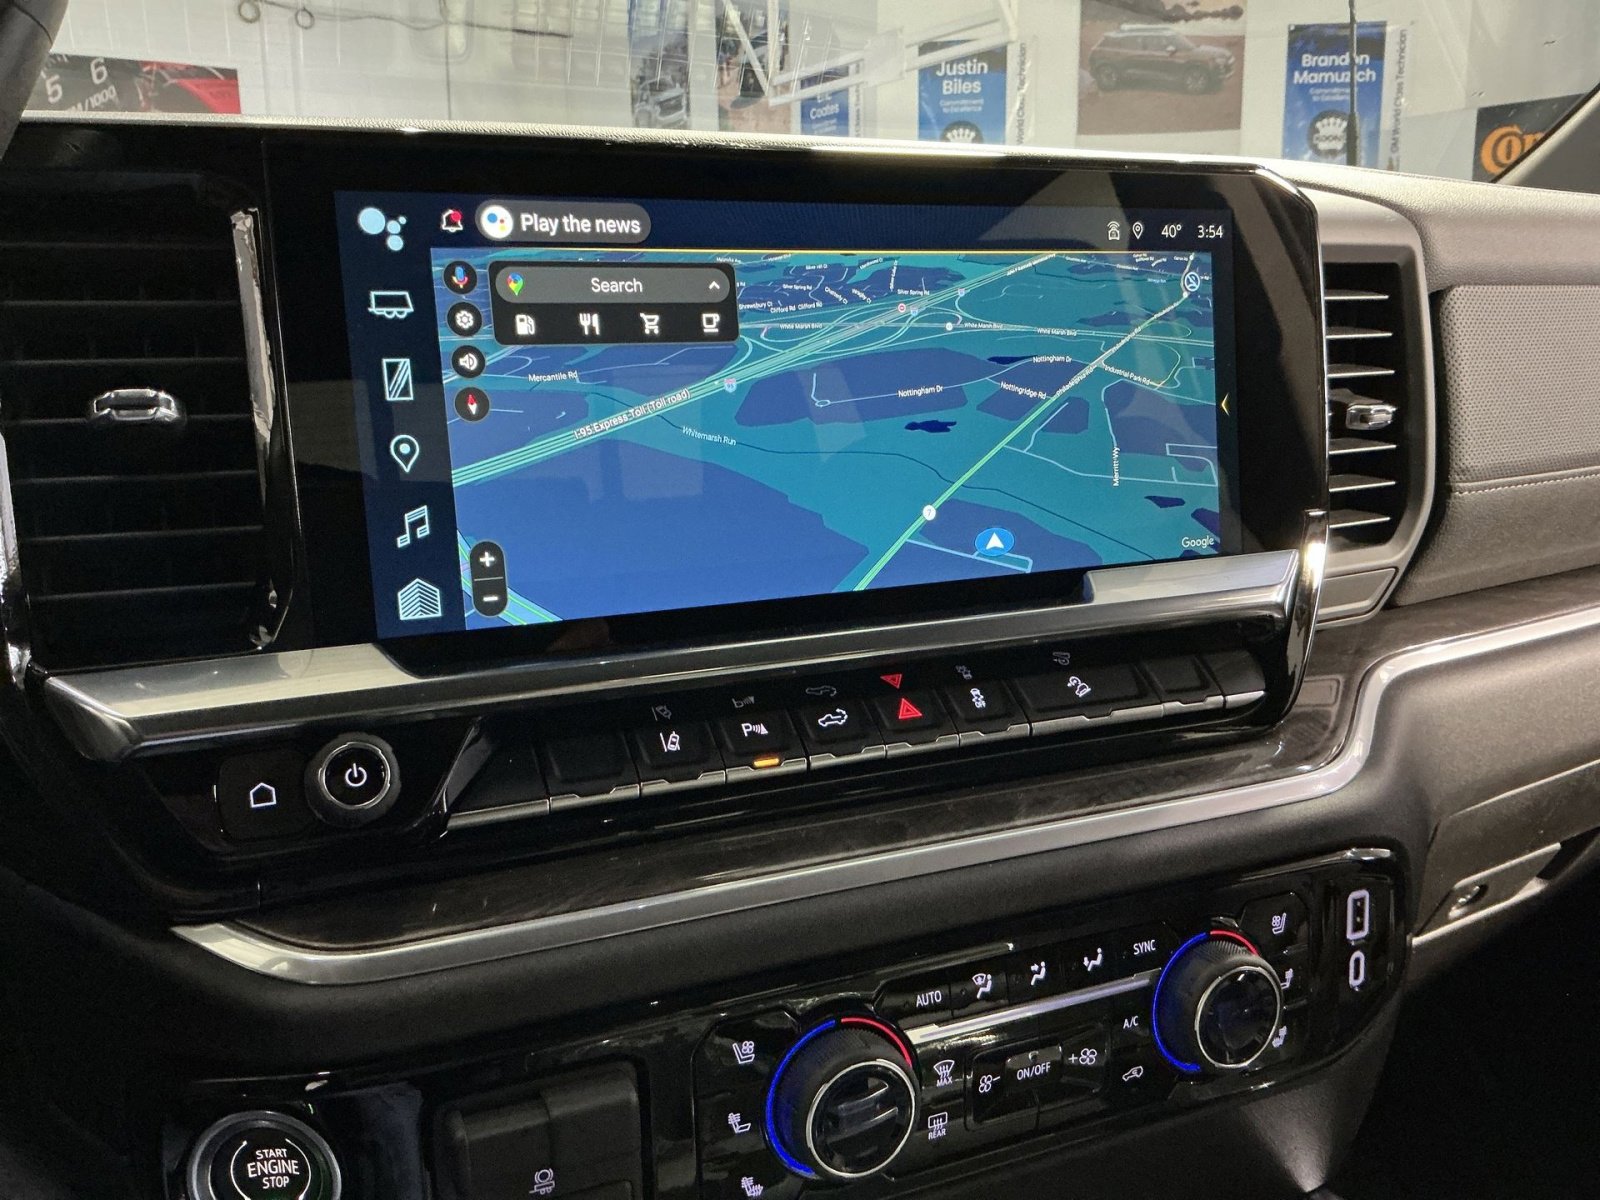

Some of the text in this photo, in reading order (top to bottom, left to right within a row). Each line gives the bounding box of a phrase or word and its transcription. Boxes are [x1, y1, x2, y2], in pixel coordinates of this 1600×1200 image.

[90, 58, 108, 85] 6
[936, 59, 988, 77] Justin
[45, 74, 63, 103] 5
[942, 78, 982, 95] Biles
[520, 213, 641, 236] Play the news
[1161, 224, 1182, 239] 40°
[1197, 225, 1224, 239] 3:54
[591, 278, 643, 294] Search
[1032, 355, 1072, 364] Nottingham Dr
[528, 370, 578, 383] Mercantile Rd
[1056, 367, 1094, 396] Philadelphia Rd
[1104, 364, 1151, 386] Industrial Park Rd
[898, 384, 944, 397] Nottingham Dr
[1000, 381, 1047, 400] Nottingridge Rd
[592, 415, 629, 434] Express
[629, 405, 647, 421] Toll
[647, 398, 668, 416] (Toll
[667, 388, 691, 407] road)
[722, 434, 737, 446] Run
[1112, 446, 1121, 487] Merritt Wy
[1181, 536, 1215, 548] Google
[1133, 940, 1157, 955] SYNC
[915, 991, 942, 1008] AUTO
[1122, 1015, 1139, 1029] A/C
[1016, 1061, 1052, 1081] ON/OFF
[936, 1077, 953, 1087] MAX
[928, 1128, 947, 1141] REAR
[255, 1148, 288, 1160] START
[247, 1159, 300, 1178] ENGINE
[262, 1176, 290, 1190] STOP
